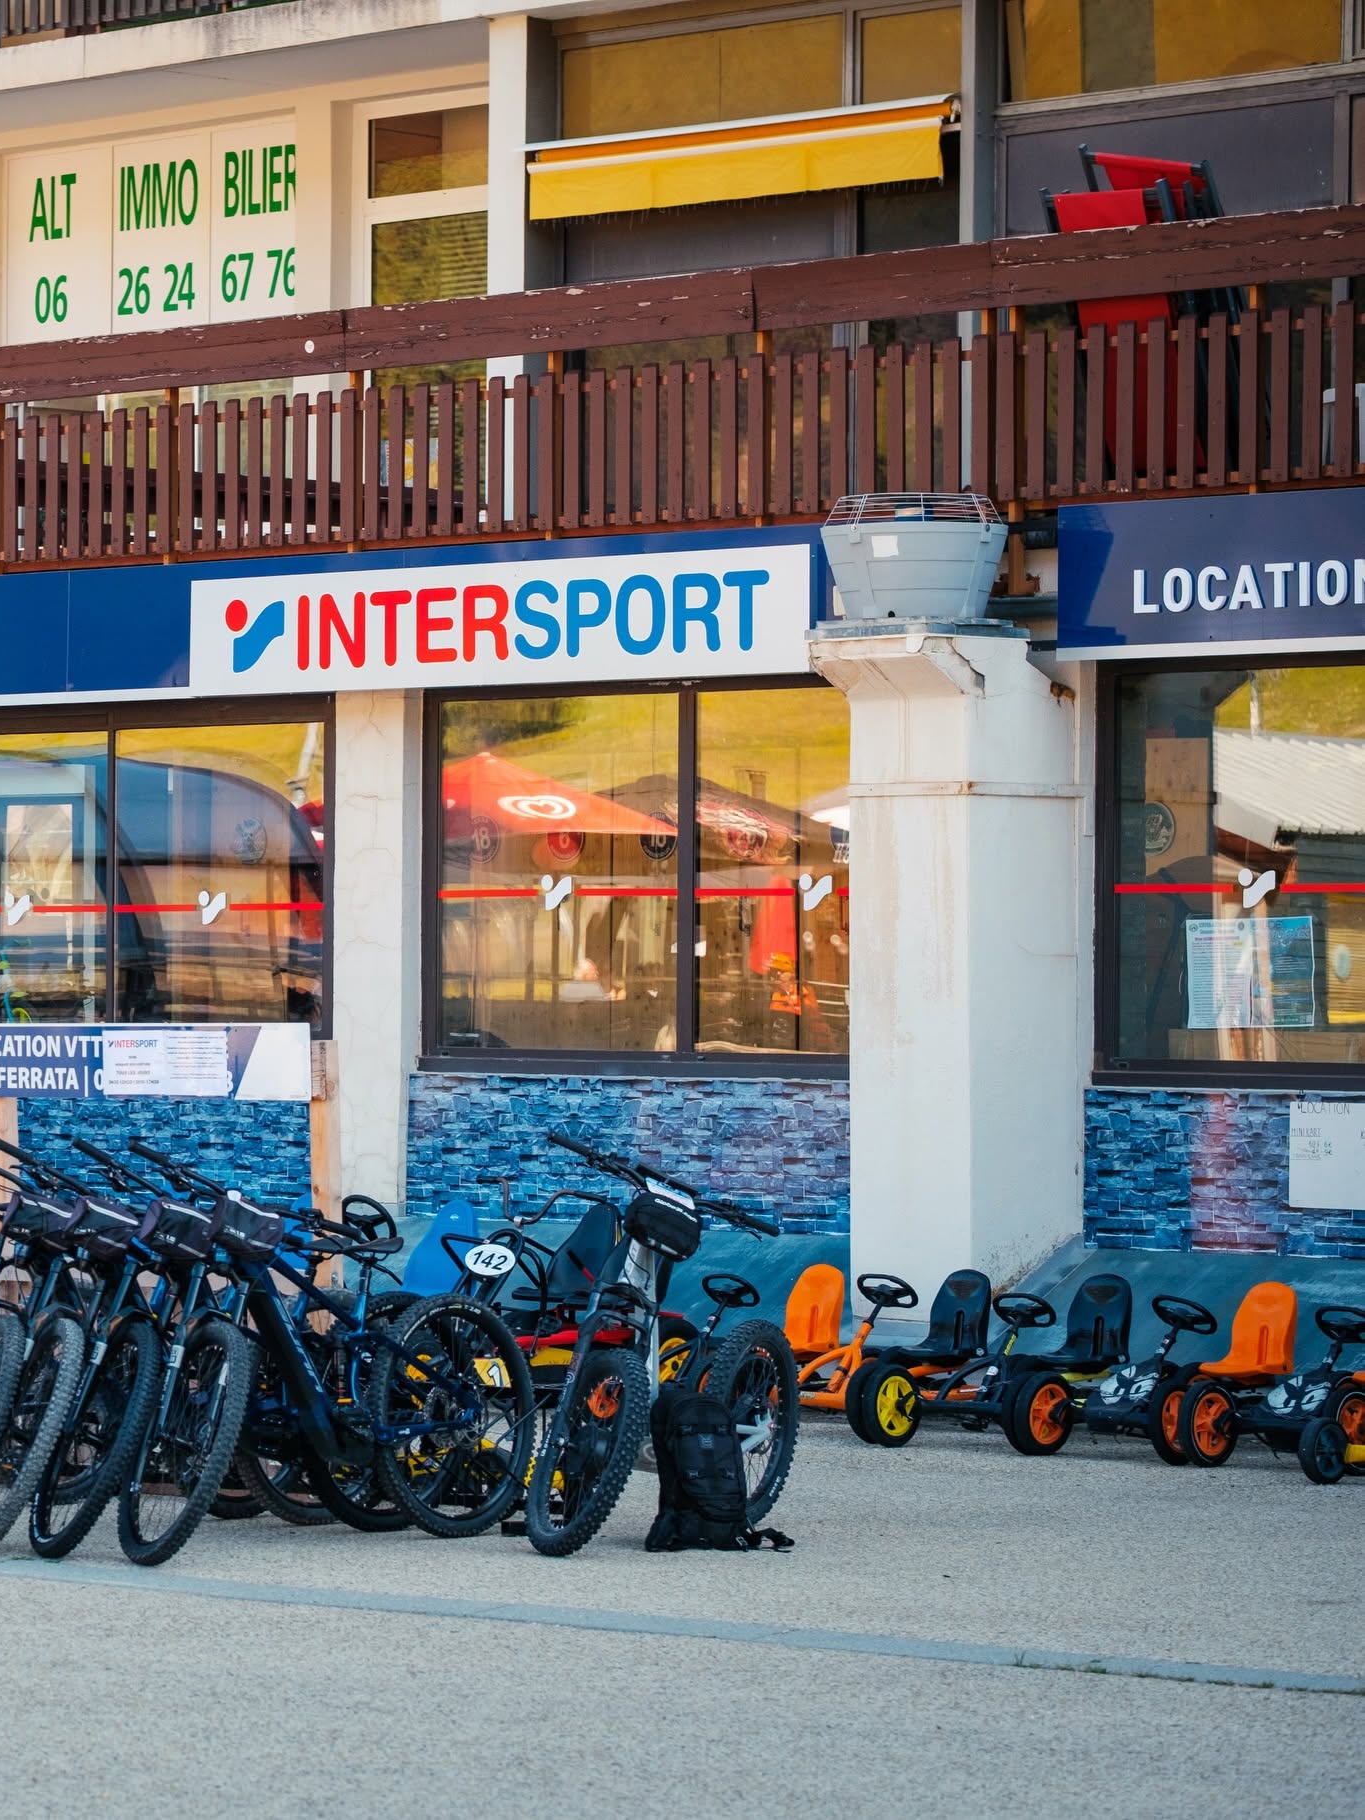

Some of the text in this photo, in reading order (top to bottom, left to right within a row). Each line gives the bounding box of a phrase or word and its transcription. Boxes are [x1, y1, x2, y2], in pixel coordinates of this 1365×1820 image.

[30, 143, 296, 242] ALT IMMO BILIER
[34, 245, 296, 324] 06 26 24 67 76
[296, 569, 770, 672] INTERSPORT
[65, 1035, 104, 1058] VTT
[114, 1039, 158, 1048] INTERSPORT
[1300, 1102, 1351, 1115] LOCATION
[472, 1250, 508, 1271] 142
